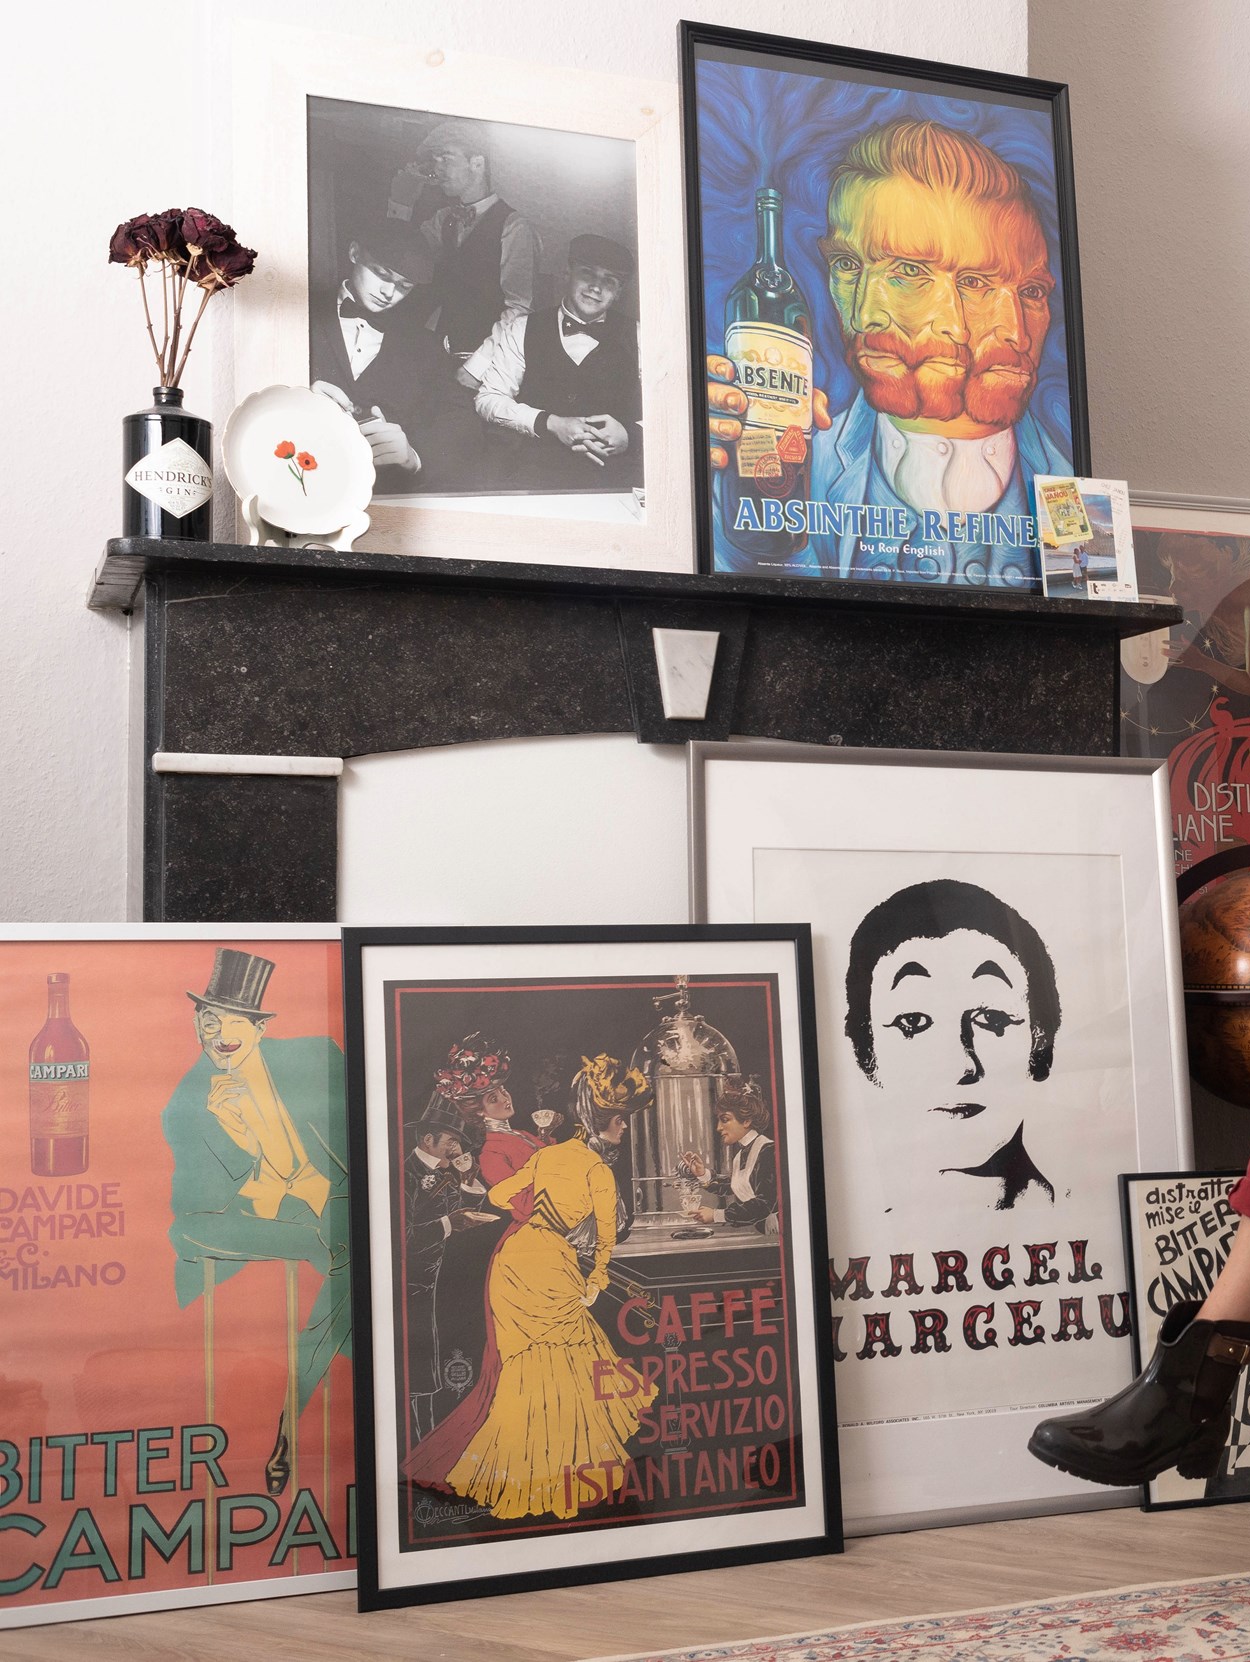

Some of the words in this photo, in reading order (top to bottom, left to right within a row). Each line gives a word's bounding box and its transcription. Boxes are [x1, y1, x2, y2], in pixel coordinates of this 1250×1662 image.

[734, 365, 809, 396] ABSENTE
[134, 470, 213, 489] HENDRICK'S
[165, 486, 191, 496] GIN
[733, 496, 911, 540] ABSINTHE
[922, 508, 1041, 548] REFINE
[859, 541, 875, 555] by
[878, 541, 900, 554] Ron
[902, 543, 945, 558] English
[1173, 814, 1234, 842] IANE
[30, 1063, 89, 1081] CAMPARI
[0, 1182, 123, 1214] DAVIDE
[0, 1211, 125, 1243] CAMPARI
[1145, 1206, 1185, 1229] mise
[1155, 1198, 1240, 1266] BITTER
[0, 1261, 126, 1291] MILANO
[829, 1239, 1103, 1301] MARCEL
[591, 1345, 779, 1402] ESPRESSO
[637, 1394, 786, 1445] SERVIZIO
[0, 1423, 230, 1509] BITTER
[564, 1443, 781, 1510] ISTANTANEO
[0, 1484, 357, 1596] CAMPA
